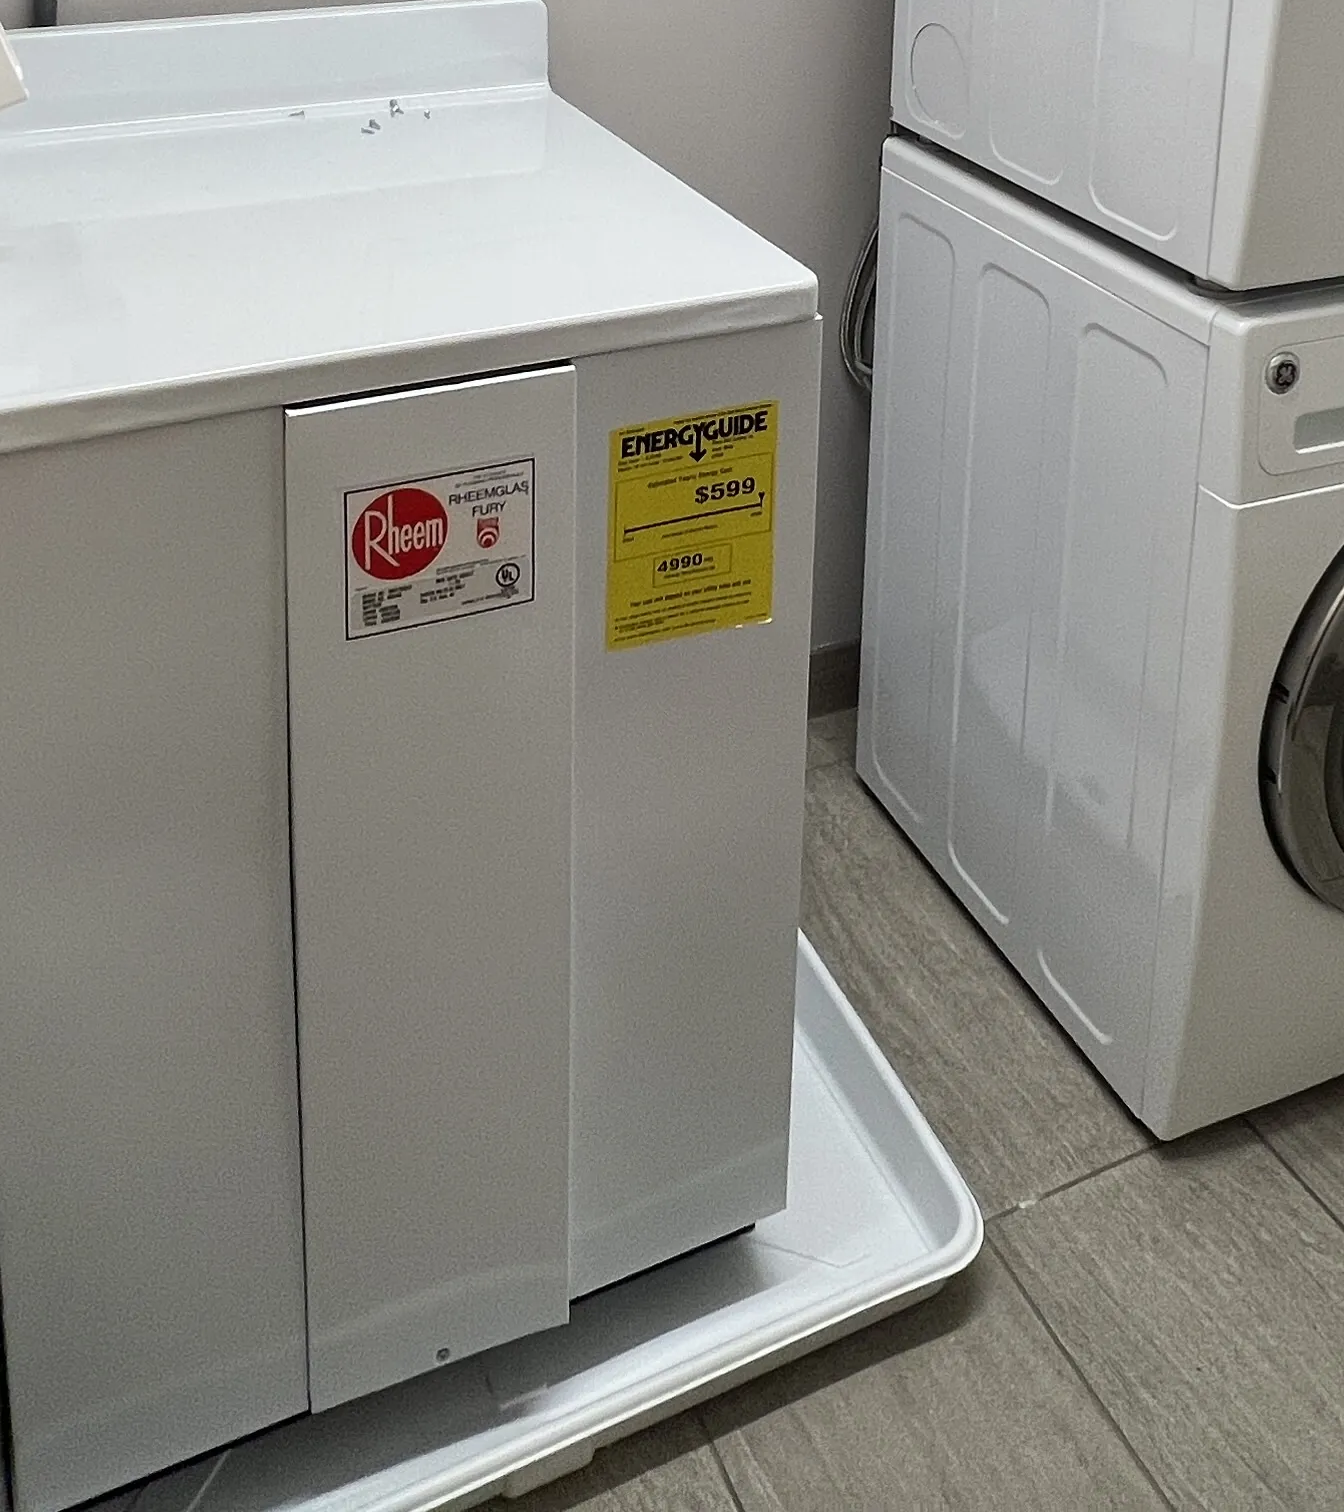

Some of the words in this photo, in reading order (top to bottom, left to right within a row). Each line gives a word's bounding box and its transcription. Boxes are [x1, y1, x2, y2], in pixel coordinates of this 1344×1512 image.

[621, 410, 768, 462] ENERGYGUIDE
[694, 476, 755, 505] $599
[471, 500, 507, 518] FURY
[364, 494, 444, 571] Rheem
[656, 552, 703, 573] 4990
